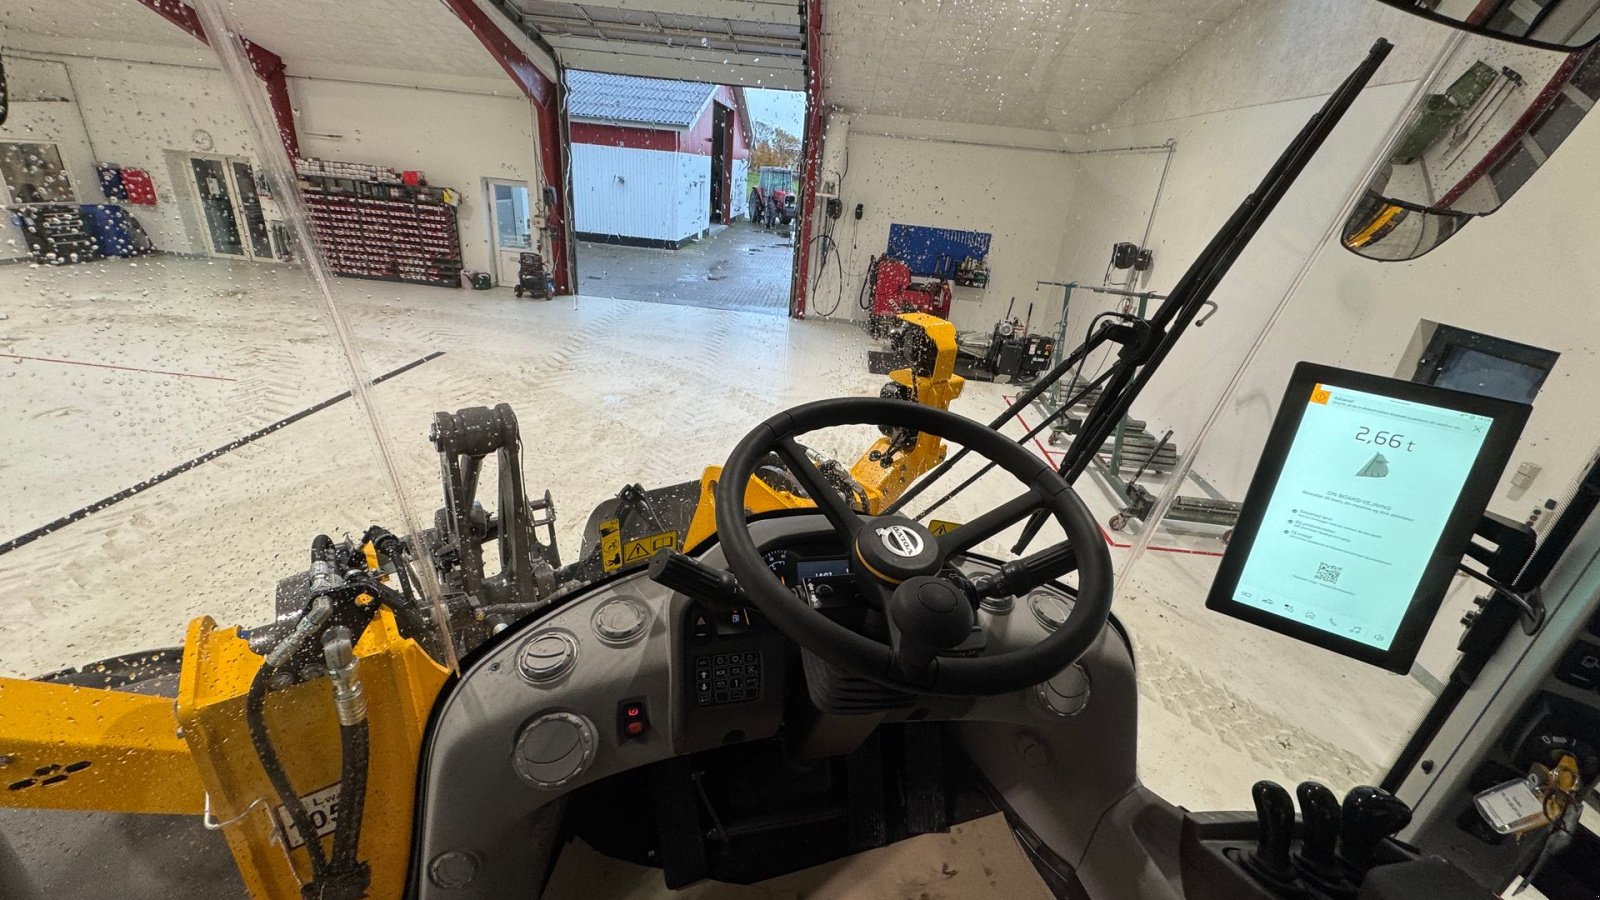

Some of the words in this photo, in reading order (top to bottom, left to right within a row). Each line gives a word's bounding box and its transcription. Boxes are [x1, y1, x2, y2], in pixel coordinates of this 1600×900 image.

[1354, 425, 1405, 449] 2,66
[1407, 440, 1416, 453] t
[892, 526, 913, 555] VOLVO
